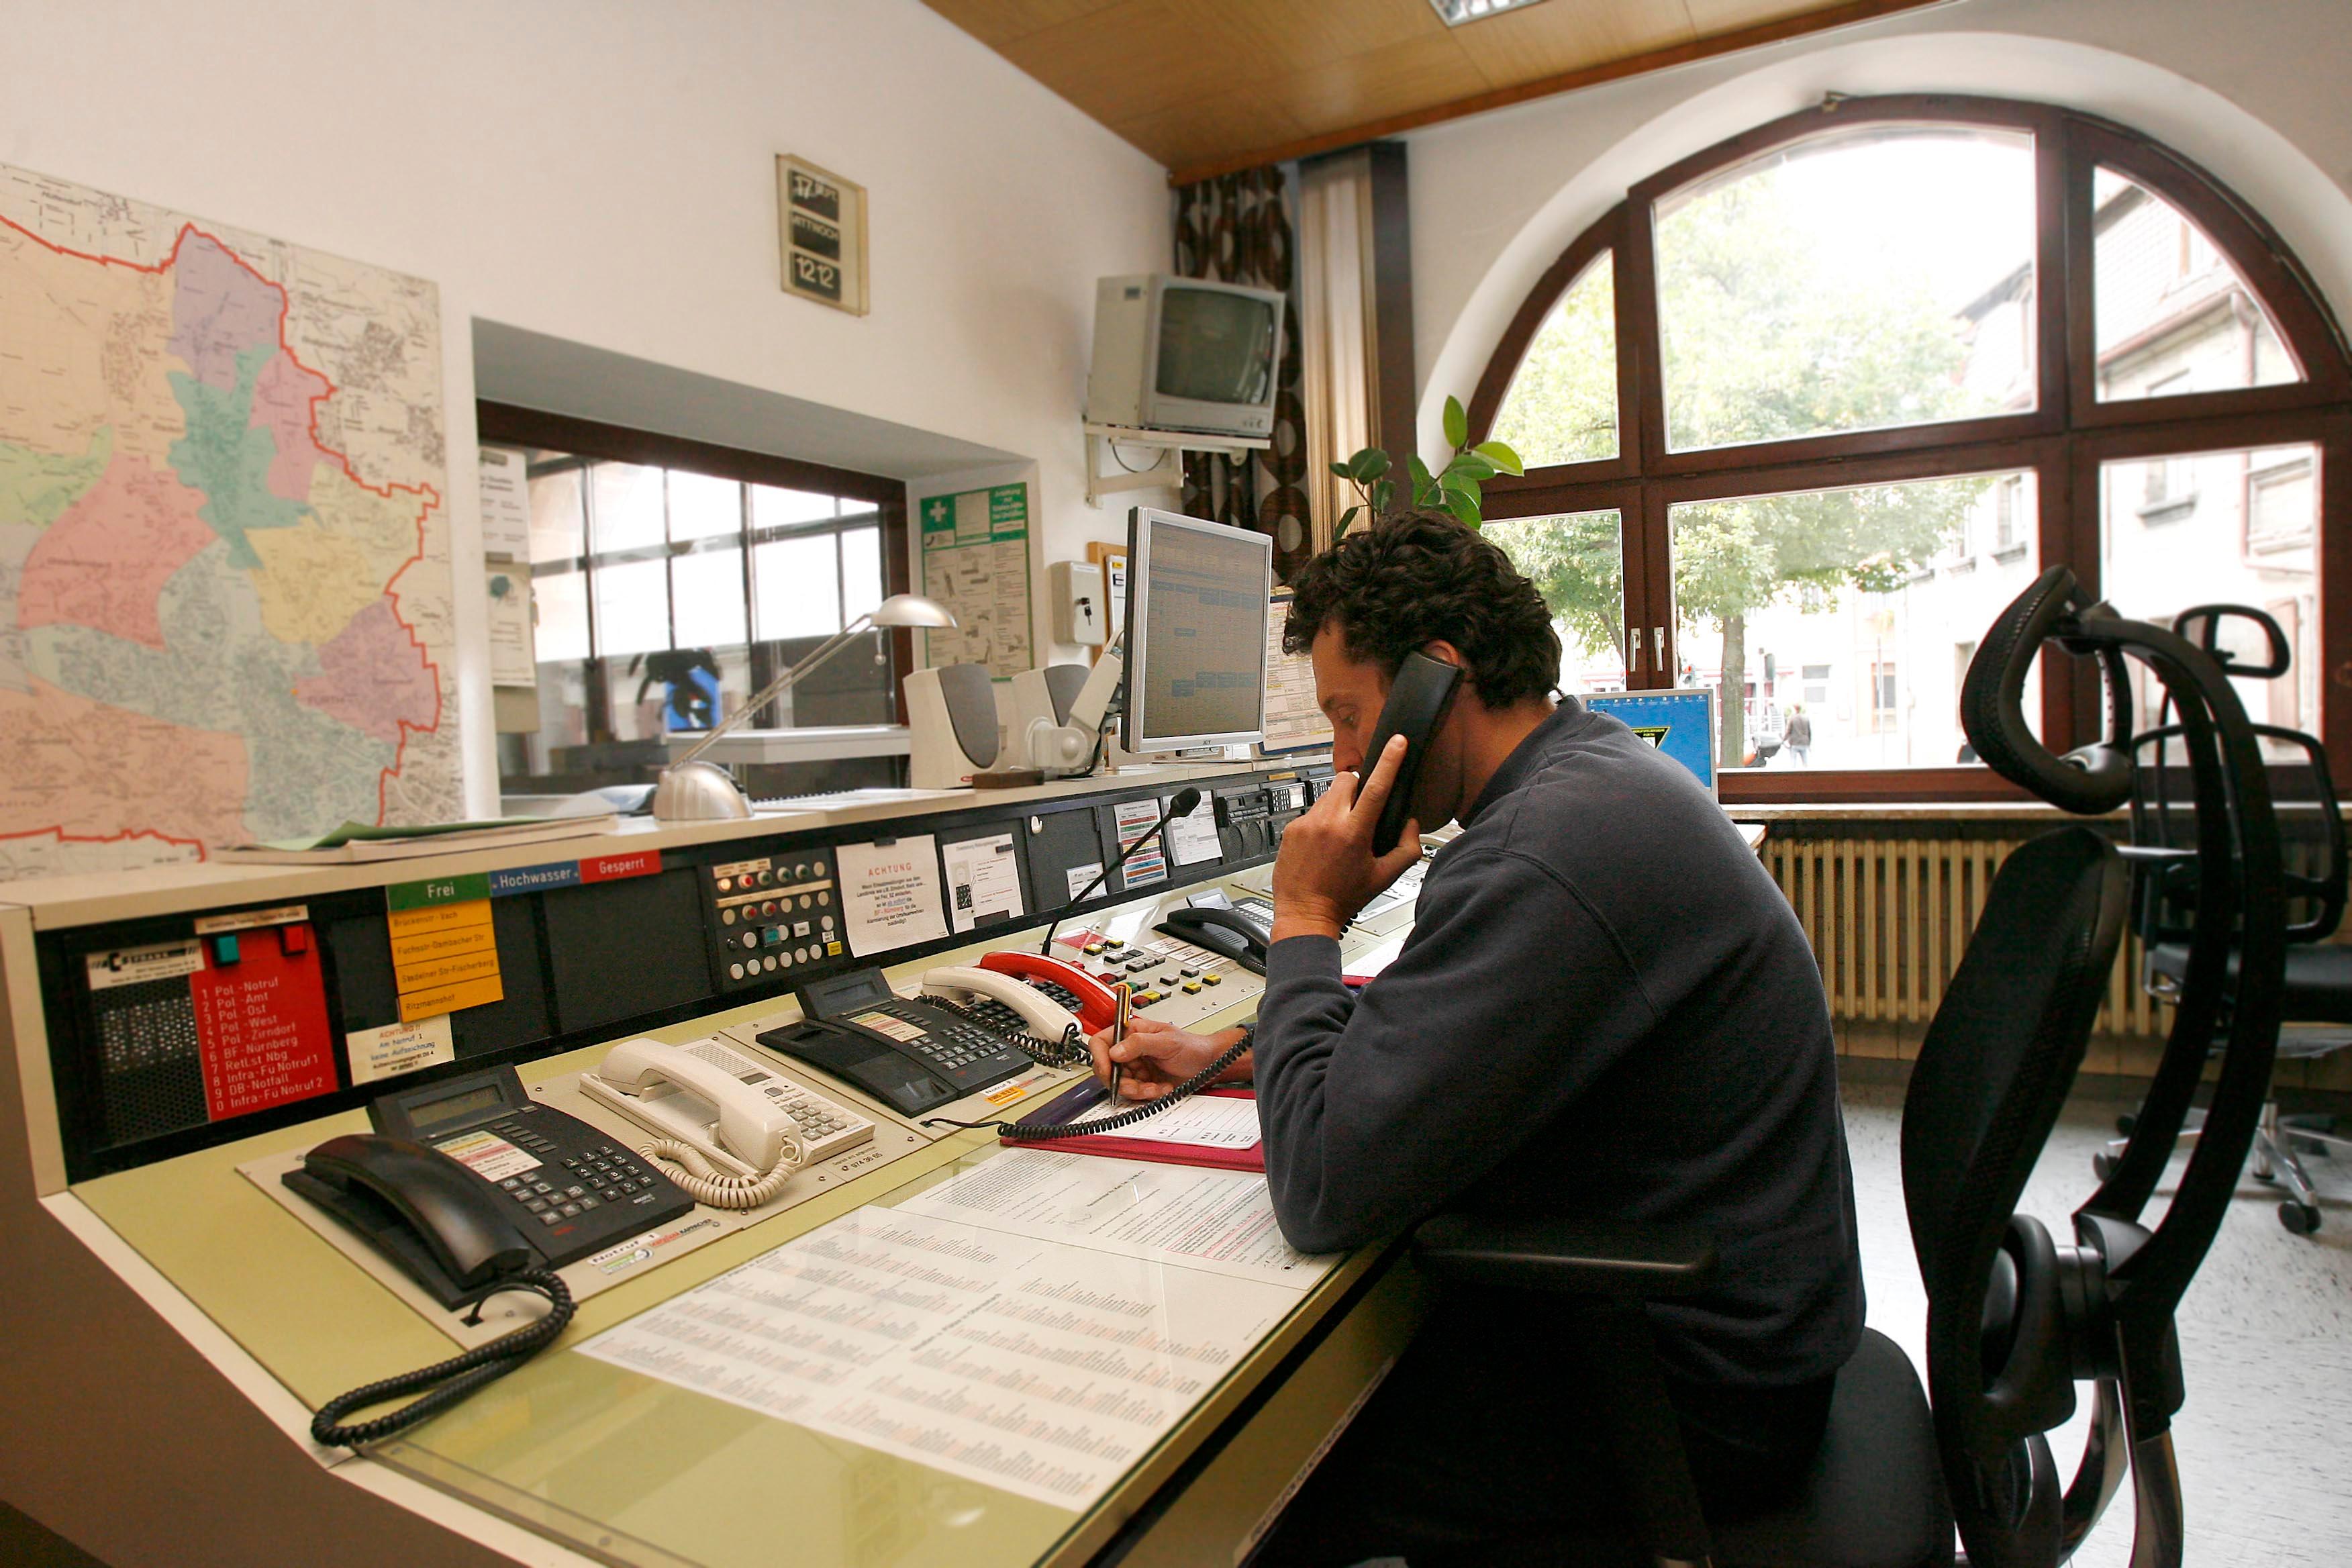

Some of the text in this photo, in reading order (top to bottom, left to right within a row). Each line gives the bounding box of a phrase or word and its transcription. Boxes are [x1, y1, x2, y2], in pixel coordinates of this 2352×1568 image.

[599, 858, 645, 874] Gesperrt
[869, 863, 912, 877] ACHTUNG
[500, 869, 571, 888] Hochwasser
[428, 883, 454, 898] Frei
[202, 989, 207, 998] 1
[203, 1001, 209, 1012] 2
[405, 994, 455, 1010] Ritzmannshof
[204, 1014, 211, 1024] 3
[207, 1026, 213, 1036] 4
[207, 1038, 215, 1049] 5
[209, 1051, 217, 1062] 6
[211, 1064, 218, 1075] 7
[266, 1050, 289, 1062] Nbg
[213, 1076, 220, 1087] 8
[277, 1055, 311, 1073] Notruf
[313, 1054, 319, 1064] 1
[281, 1080, 314, 1096] Notruf
[316, 1077, 323, 1087] 2
[215, 1089, 222, 1099] 9
[593, 1240, 638, 1263] Notruf
